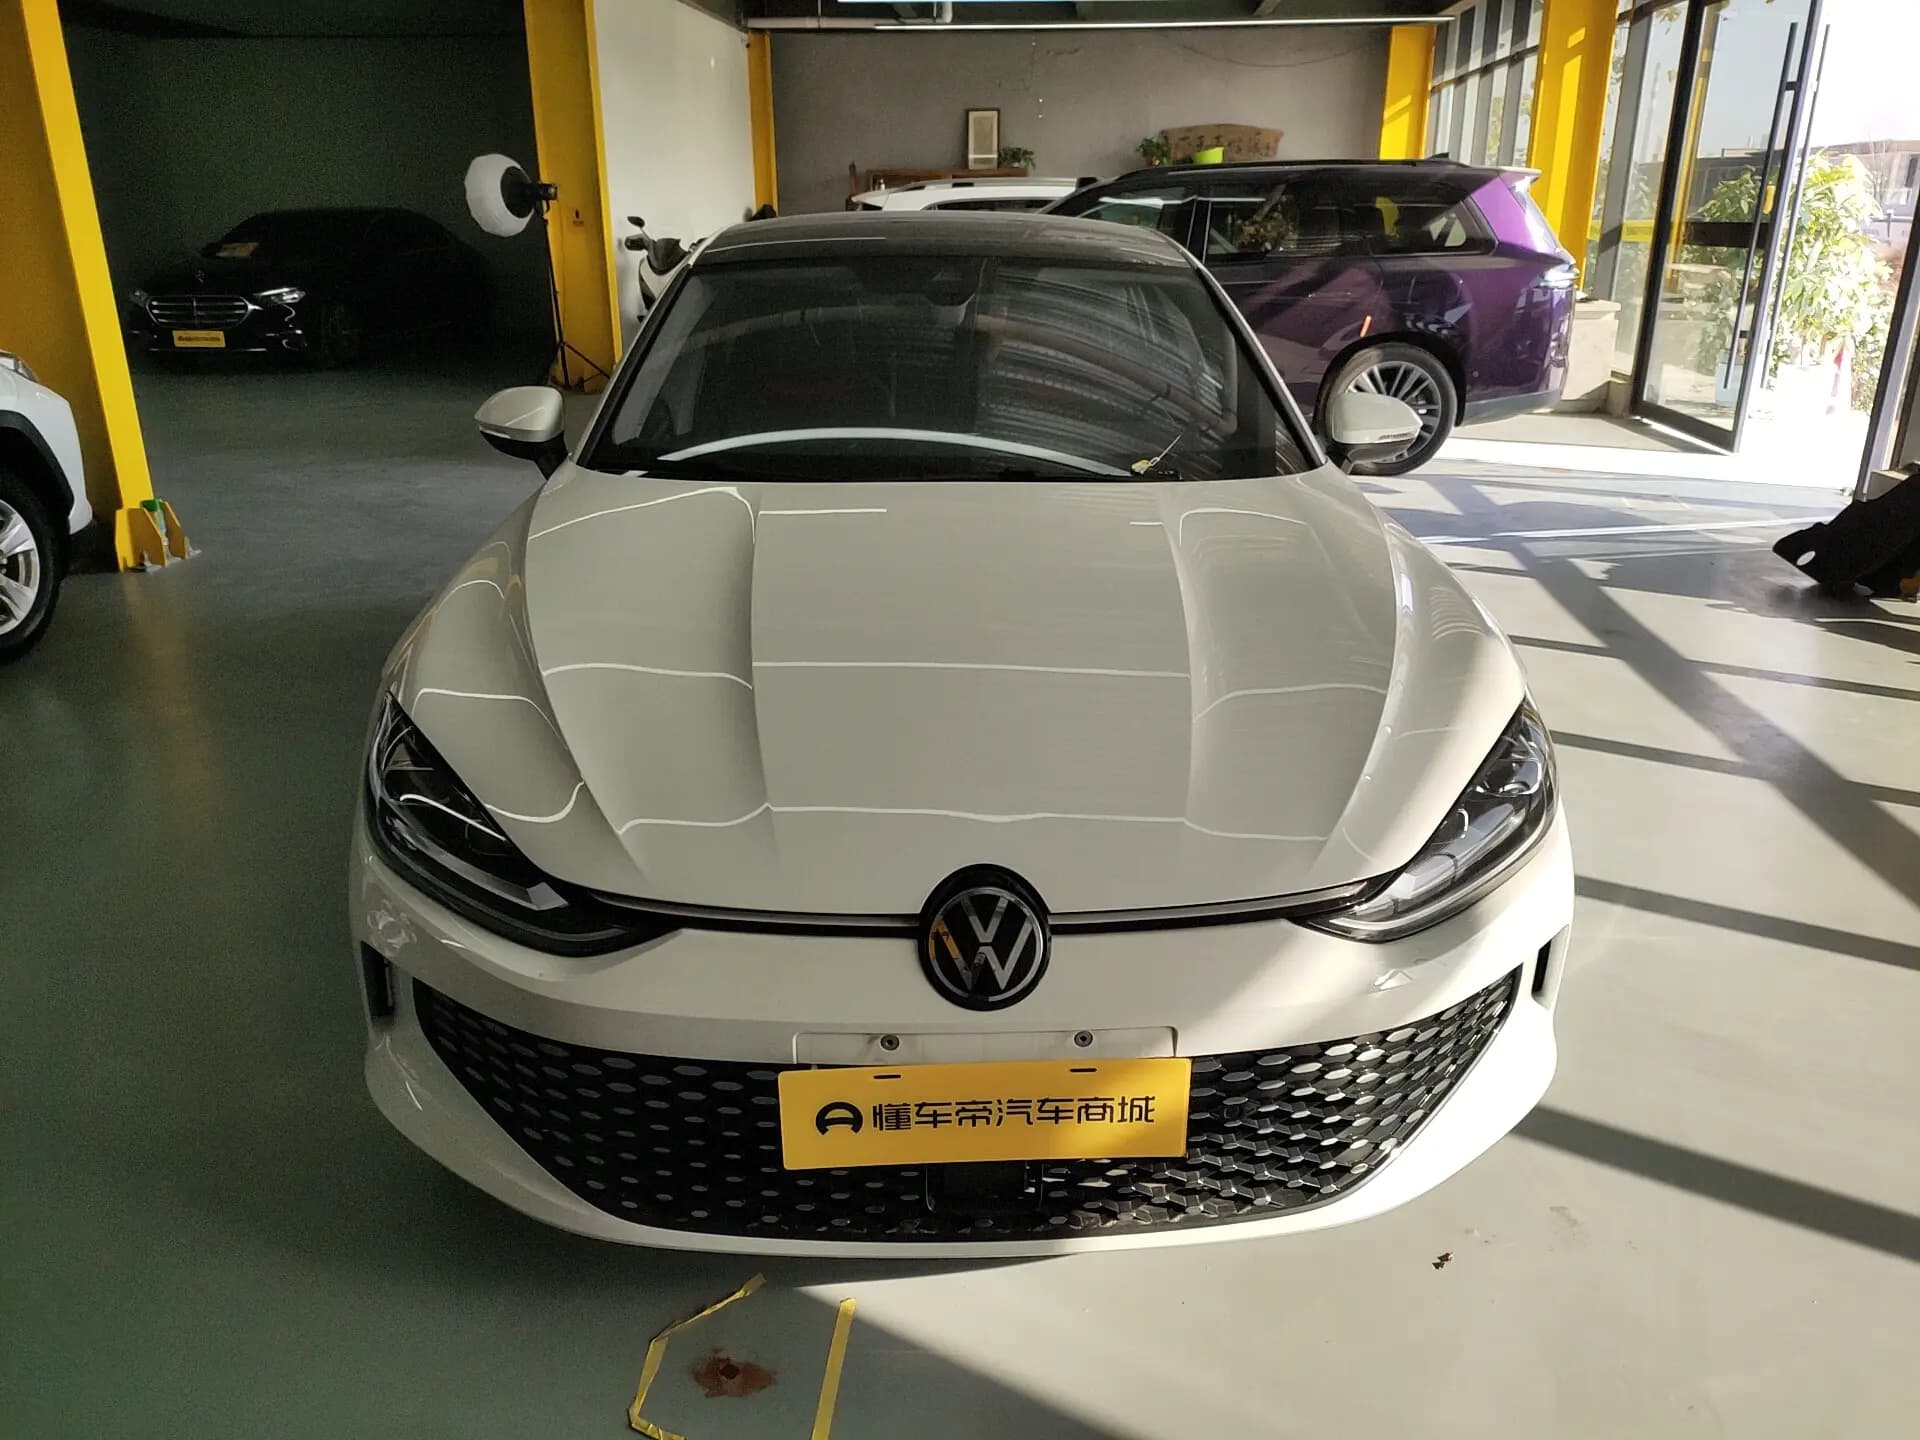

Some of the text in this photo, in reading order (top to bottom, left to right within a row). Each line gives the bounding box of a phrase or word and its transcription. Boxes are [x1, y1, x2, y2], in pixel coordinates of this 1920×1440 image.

[872, 1096, 1156, 1131] 懂车帝汽车商城
